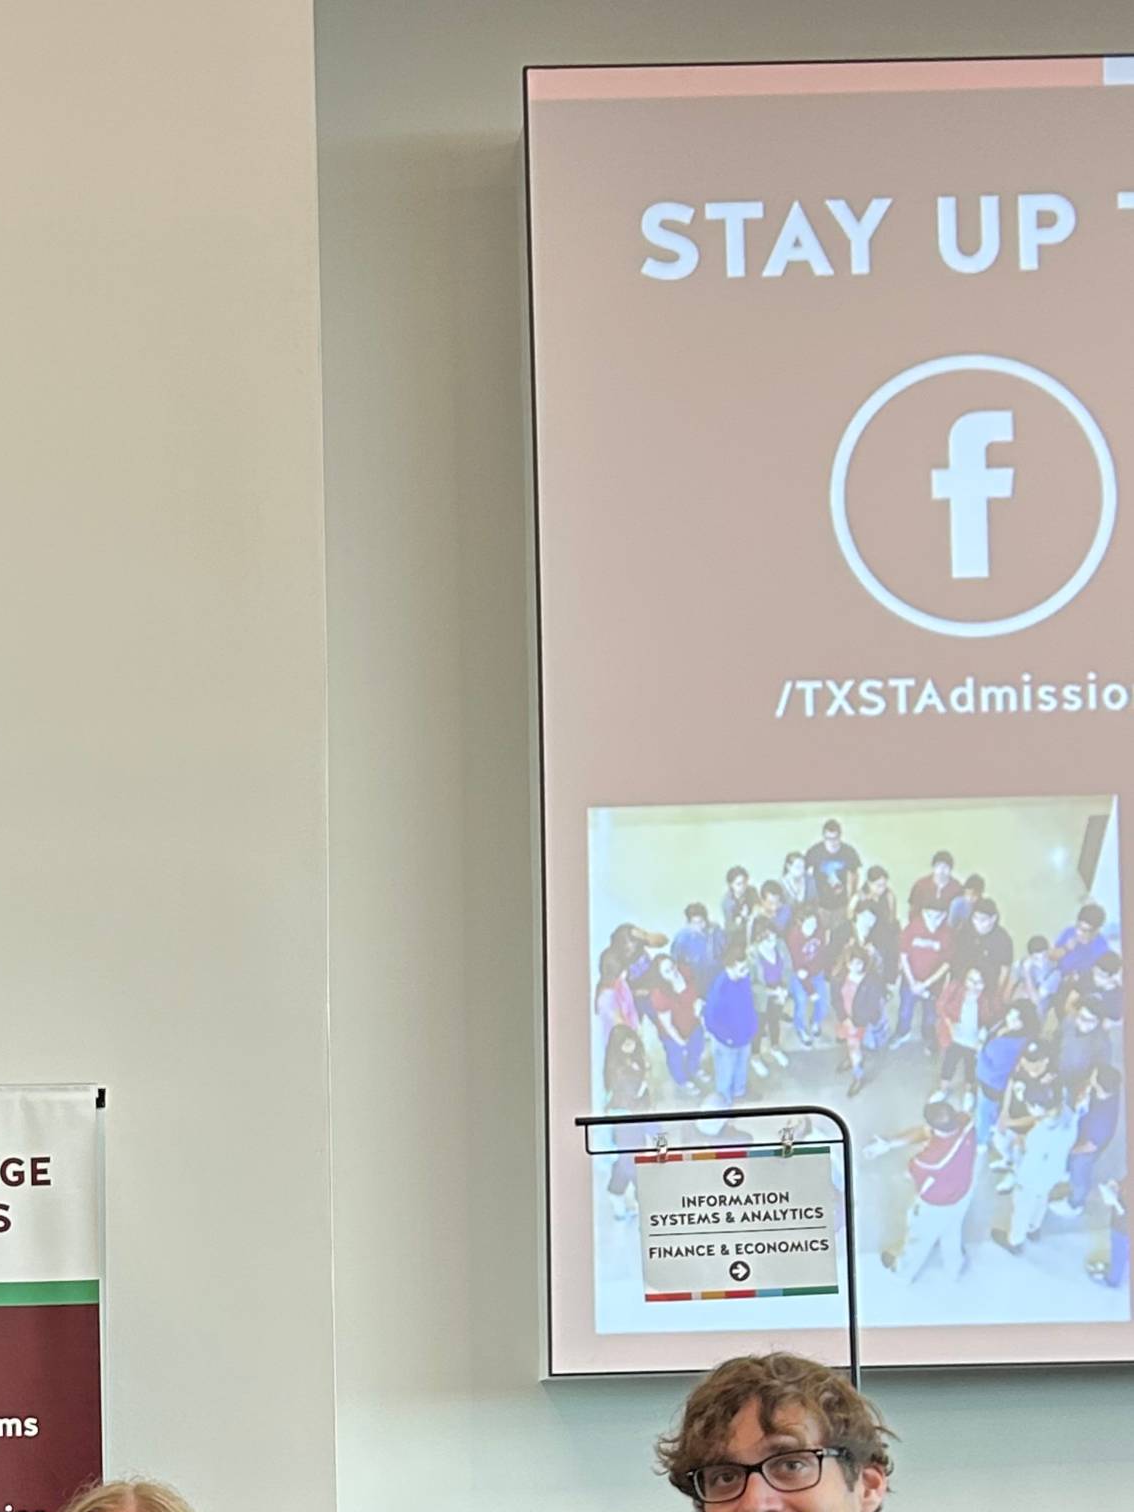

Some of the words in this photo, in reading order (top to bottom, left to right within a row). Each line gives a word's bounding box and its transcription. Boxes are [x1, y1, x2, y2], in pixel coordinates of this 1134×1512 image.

[640, 198, 894, 281] STAY
[937, 193, 1076, 274] UP
[774, 672, 1134, 718] /TXSTAdmissio
[681, 1192, 789, 1208] INFORMATION
[649, 1212, 721, 1226] SYSTEMS
[725, 1212, 735, 1224] &
[740, 1207, 824, 1223] ANALYTICS
[649, 1244, 716, 1259] FINANCE
[720, 1244, 730, 1256] &
[735, 1240, 829, 1255] ECONOMICS
